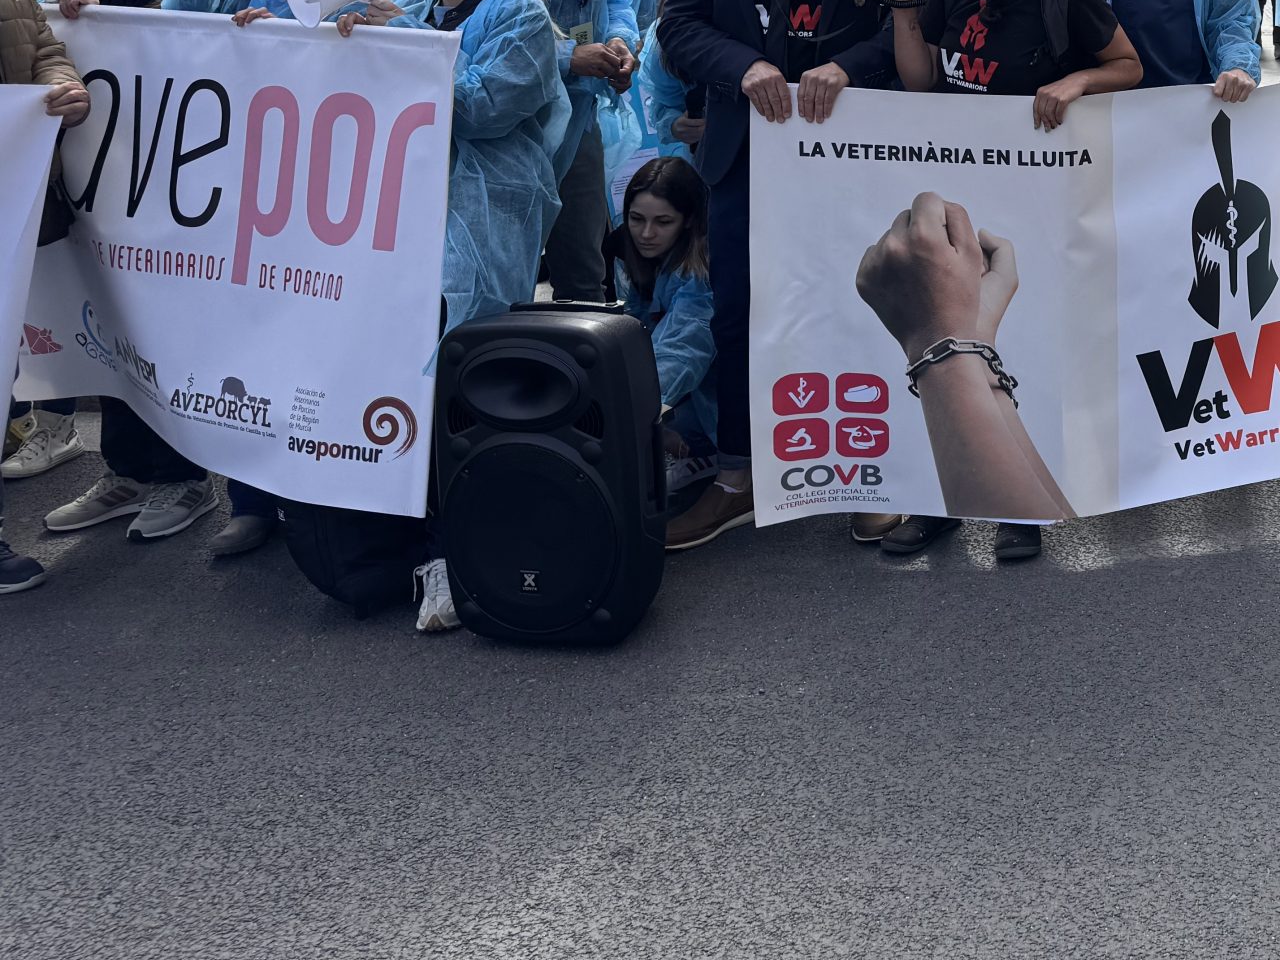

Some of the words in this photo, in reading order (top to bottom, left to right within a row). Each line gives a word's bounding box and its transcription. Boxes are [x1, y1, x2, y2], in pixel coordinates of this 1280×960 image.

[799, 141, 825, 157] LA
[831, 142, 976, 165] VETERINÀRIA
[982, 149, 1010, 166] EN
[1018, 148, 1092, 167] LLUITA
[109, 244, 226, 281] VETERINARIOS
[259, 263, 277, 289] DE
[284, 267, 343, 302] PORCINO
[170, 388, 271, 428] AVEPORCYL
[318, 391, 326, 399] de
[298, 404, 316, 415] Porcino
[781, 464, 883, 491] COVB
[774, 498, 827, 511] VETERINARIS
